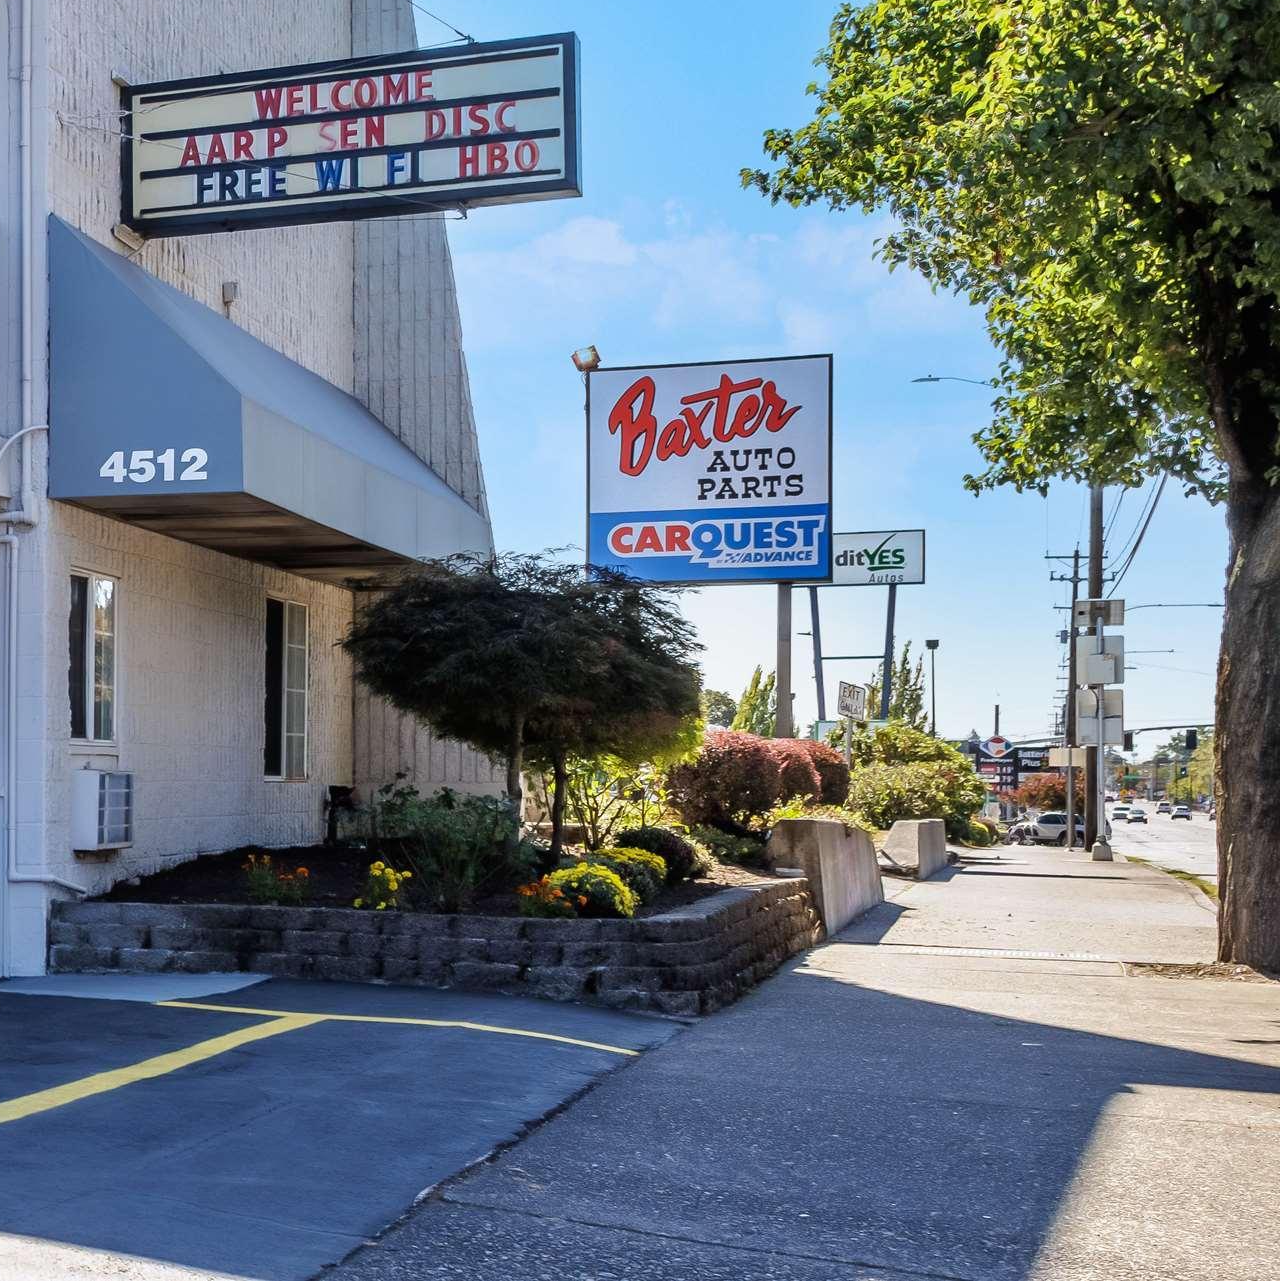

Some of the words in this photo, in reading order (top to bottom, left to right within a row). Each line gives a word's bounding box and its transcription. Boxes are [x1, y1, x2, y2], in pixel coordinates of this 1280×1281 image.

[255, 69, 436, 120] WELCOME
[180, 128, 288, 167] AARP
[319, 115, 385, 150] SEN
[425, 100, 516, 140] DISC
[197, 167, 287, 204] FREE
[459, 139, 540, 177] HBO
[608, 374, 802, 477] Baxter
[100, 448, 208, 482] 4512
[707, 447, 795, 472] AUTO
[697, 474, 803, 500] PARTS
[611, 520, 820, 558] CARQUEST
[835, 534, 905, 566] ditYES
[742, 550, 812, 563] ADVANCE
[868, 573, 904, 583] Autos
[843, 686, 860, 701] EXIT
